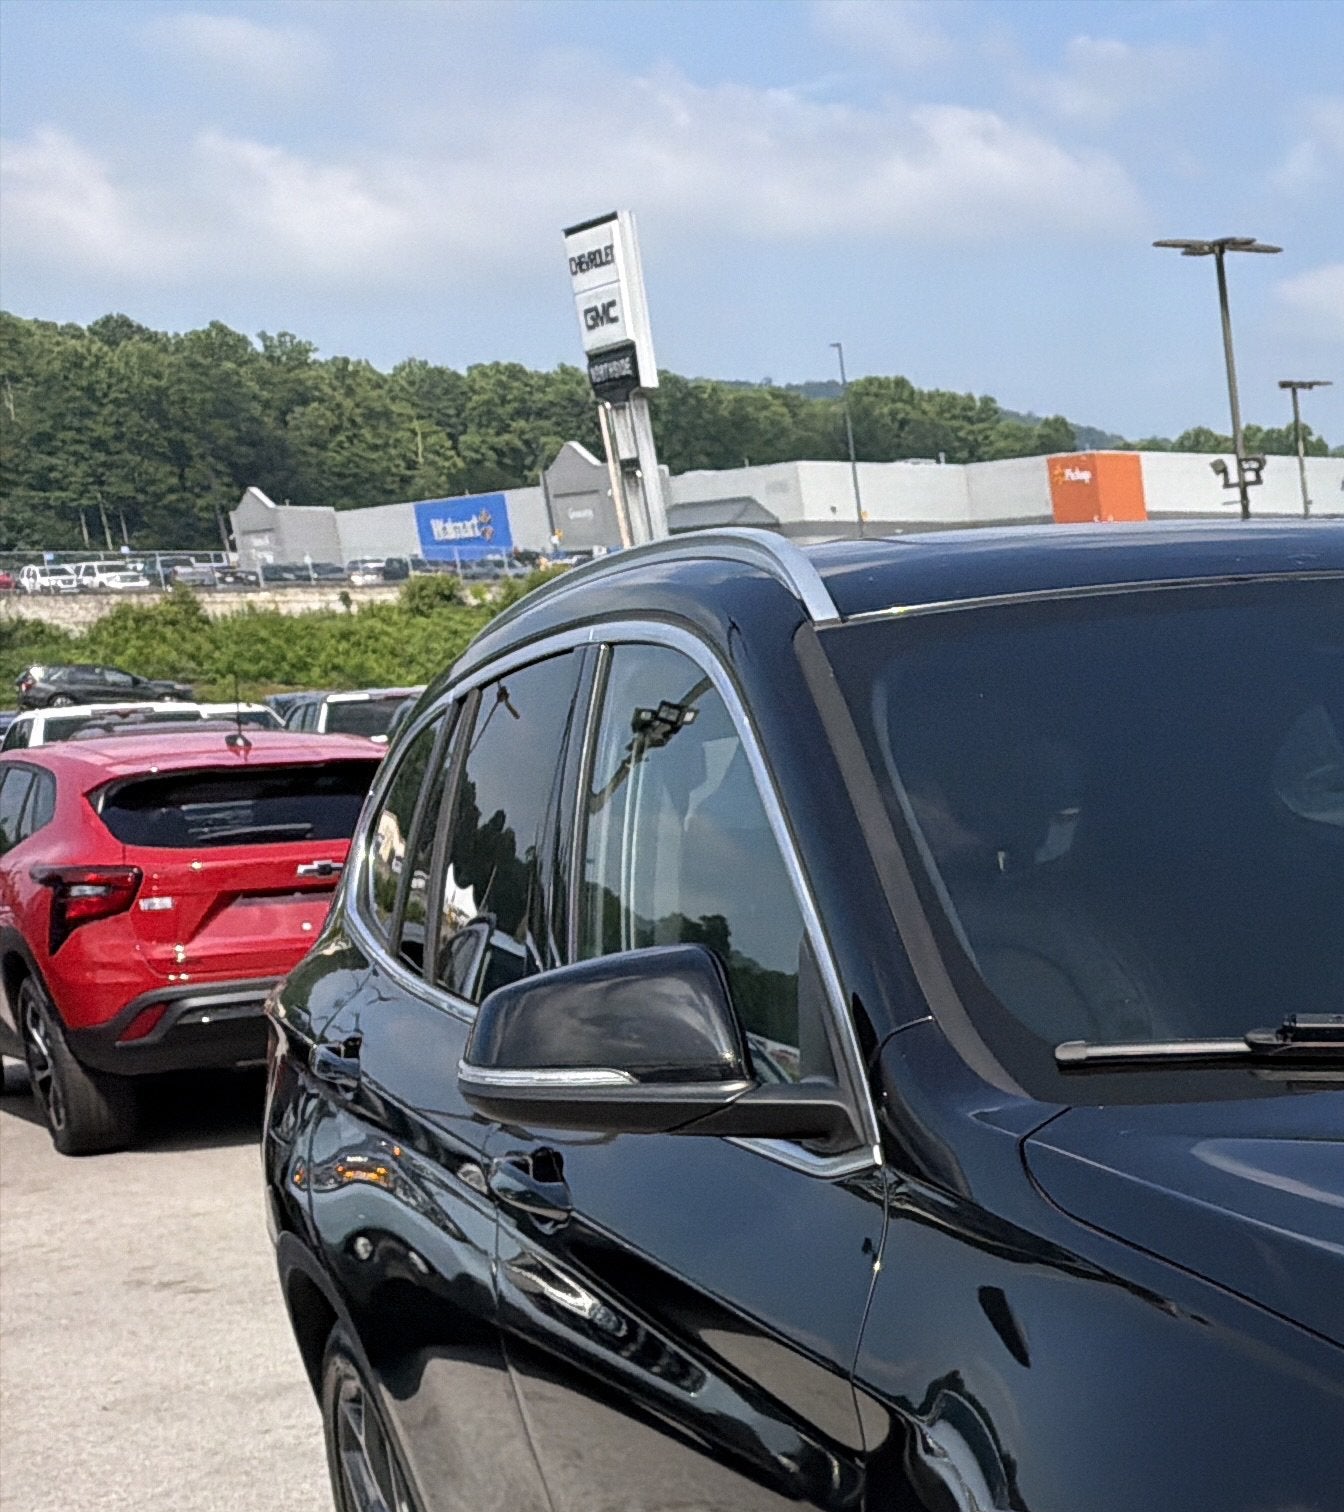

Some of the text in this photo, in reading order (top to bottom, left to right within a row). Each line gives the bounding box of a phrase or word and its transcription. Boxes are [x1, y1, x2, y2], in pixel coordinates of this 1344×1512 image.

[569, 244, 615, 276] CHEVROLET
[583, 299, 619, 331] GMC
[430, 514, 480, 541] Walmart
